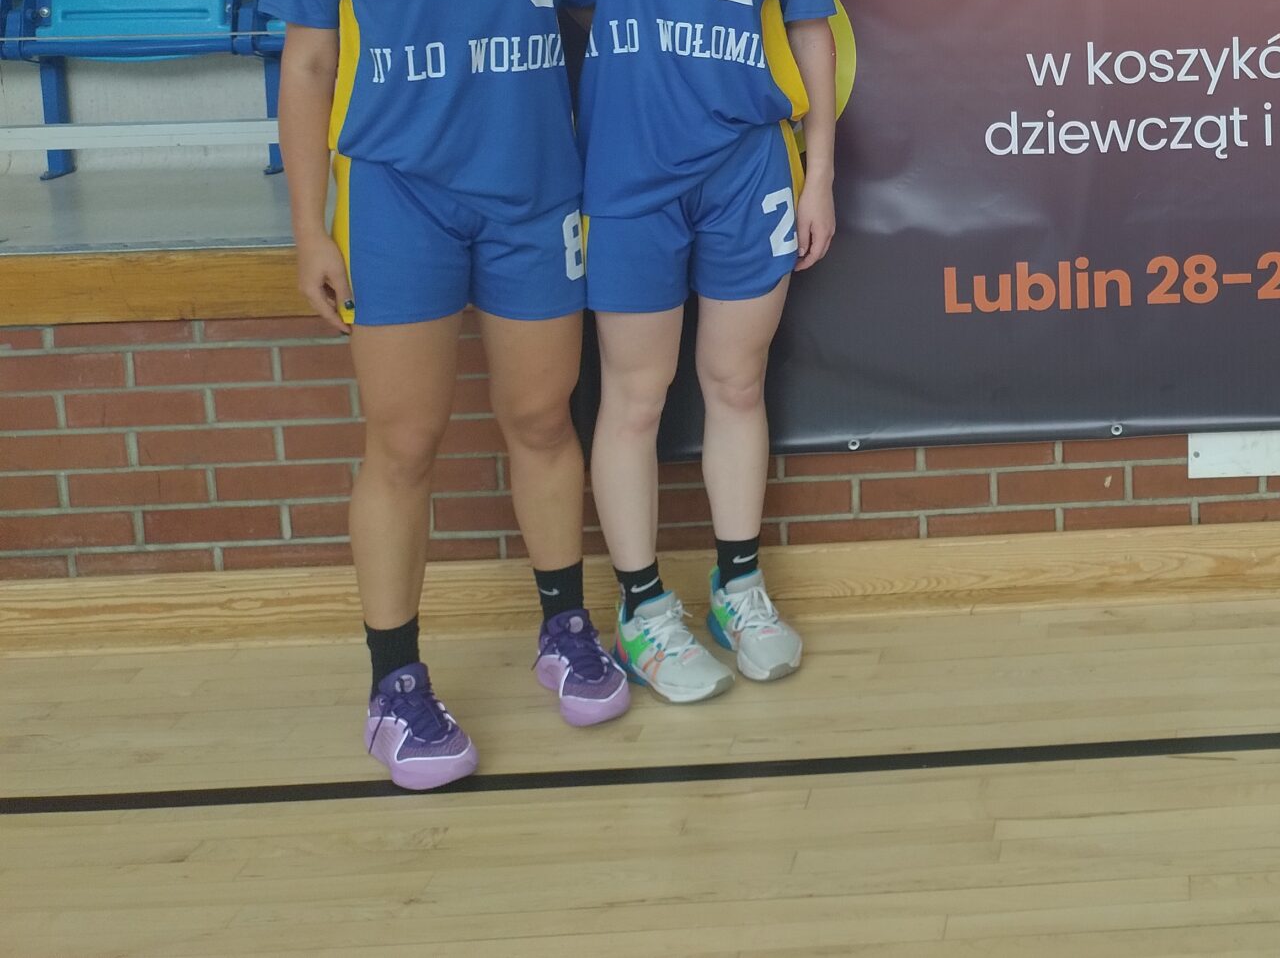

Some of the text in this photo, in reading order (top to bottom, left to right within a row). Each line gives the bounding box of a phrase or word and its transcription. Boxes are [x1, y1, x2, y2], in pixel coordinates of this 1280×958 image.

[609, 18, 640, 54] LO
[405, 42, 446, 81] LO
[1026, 52, 1072, 86] w
[984, 107, 1249, 160] dziewcząt
[1263, 102, 1273, 146] i
[761, 187, 799, 257] 2
[943, 256, 1132, 313] Lublin
